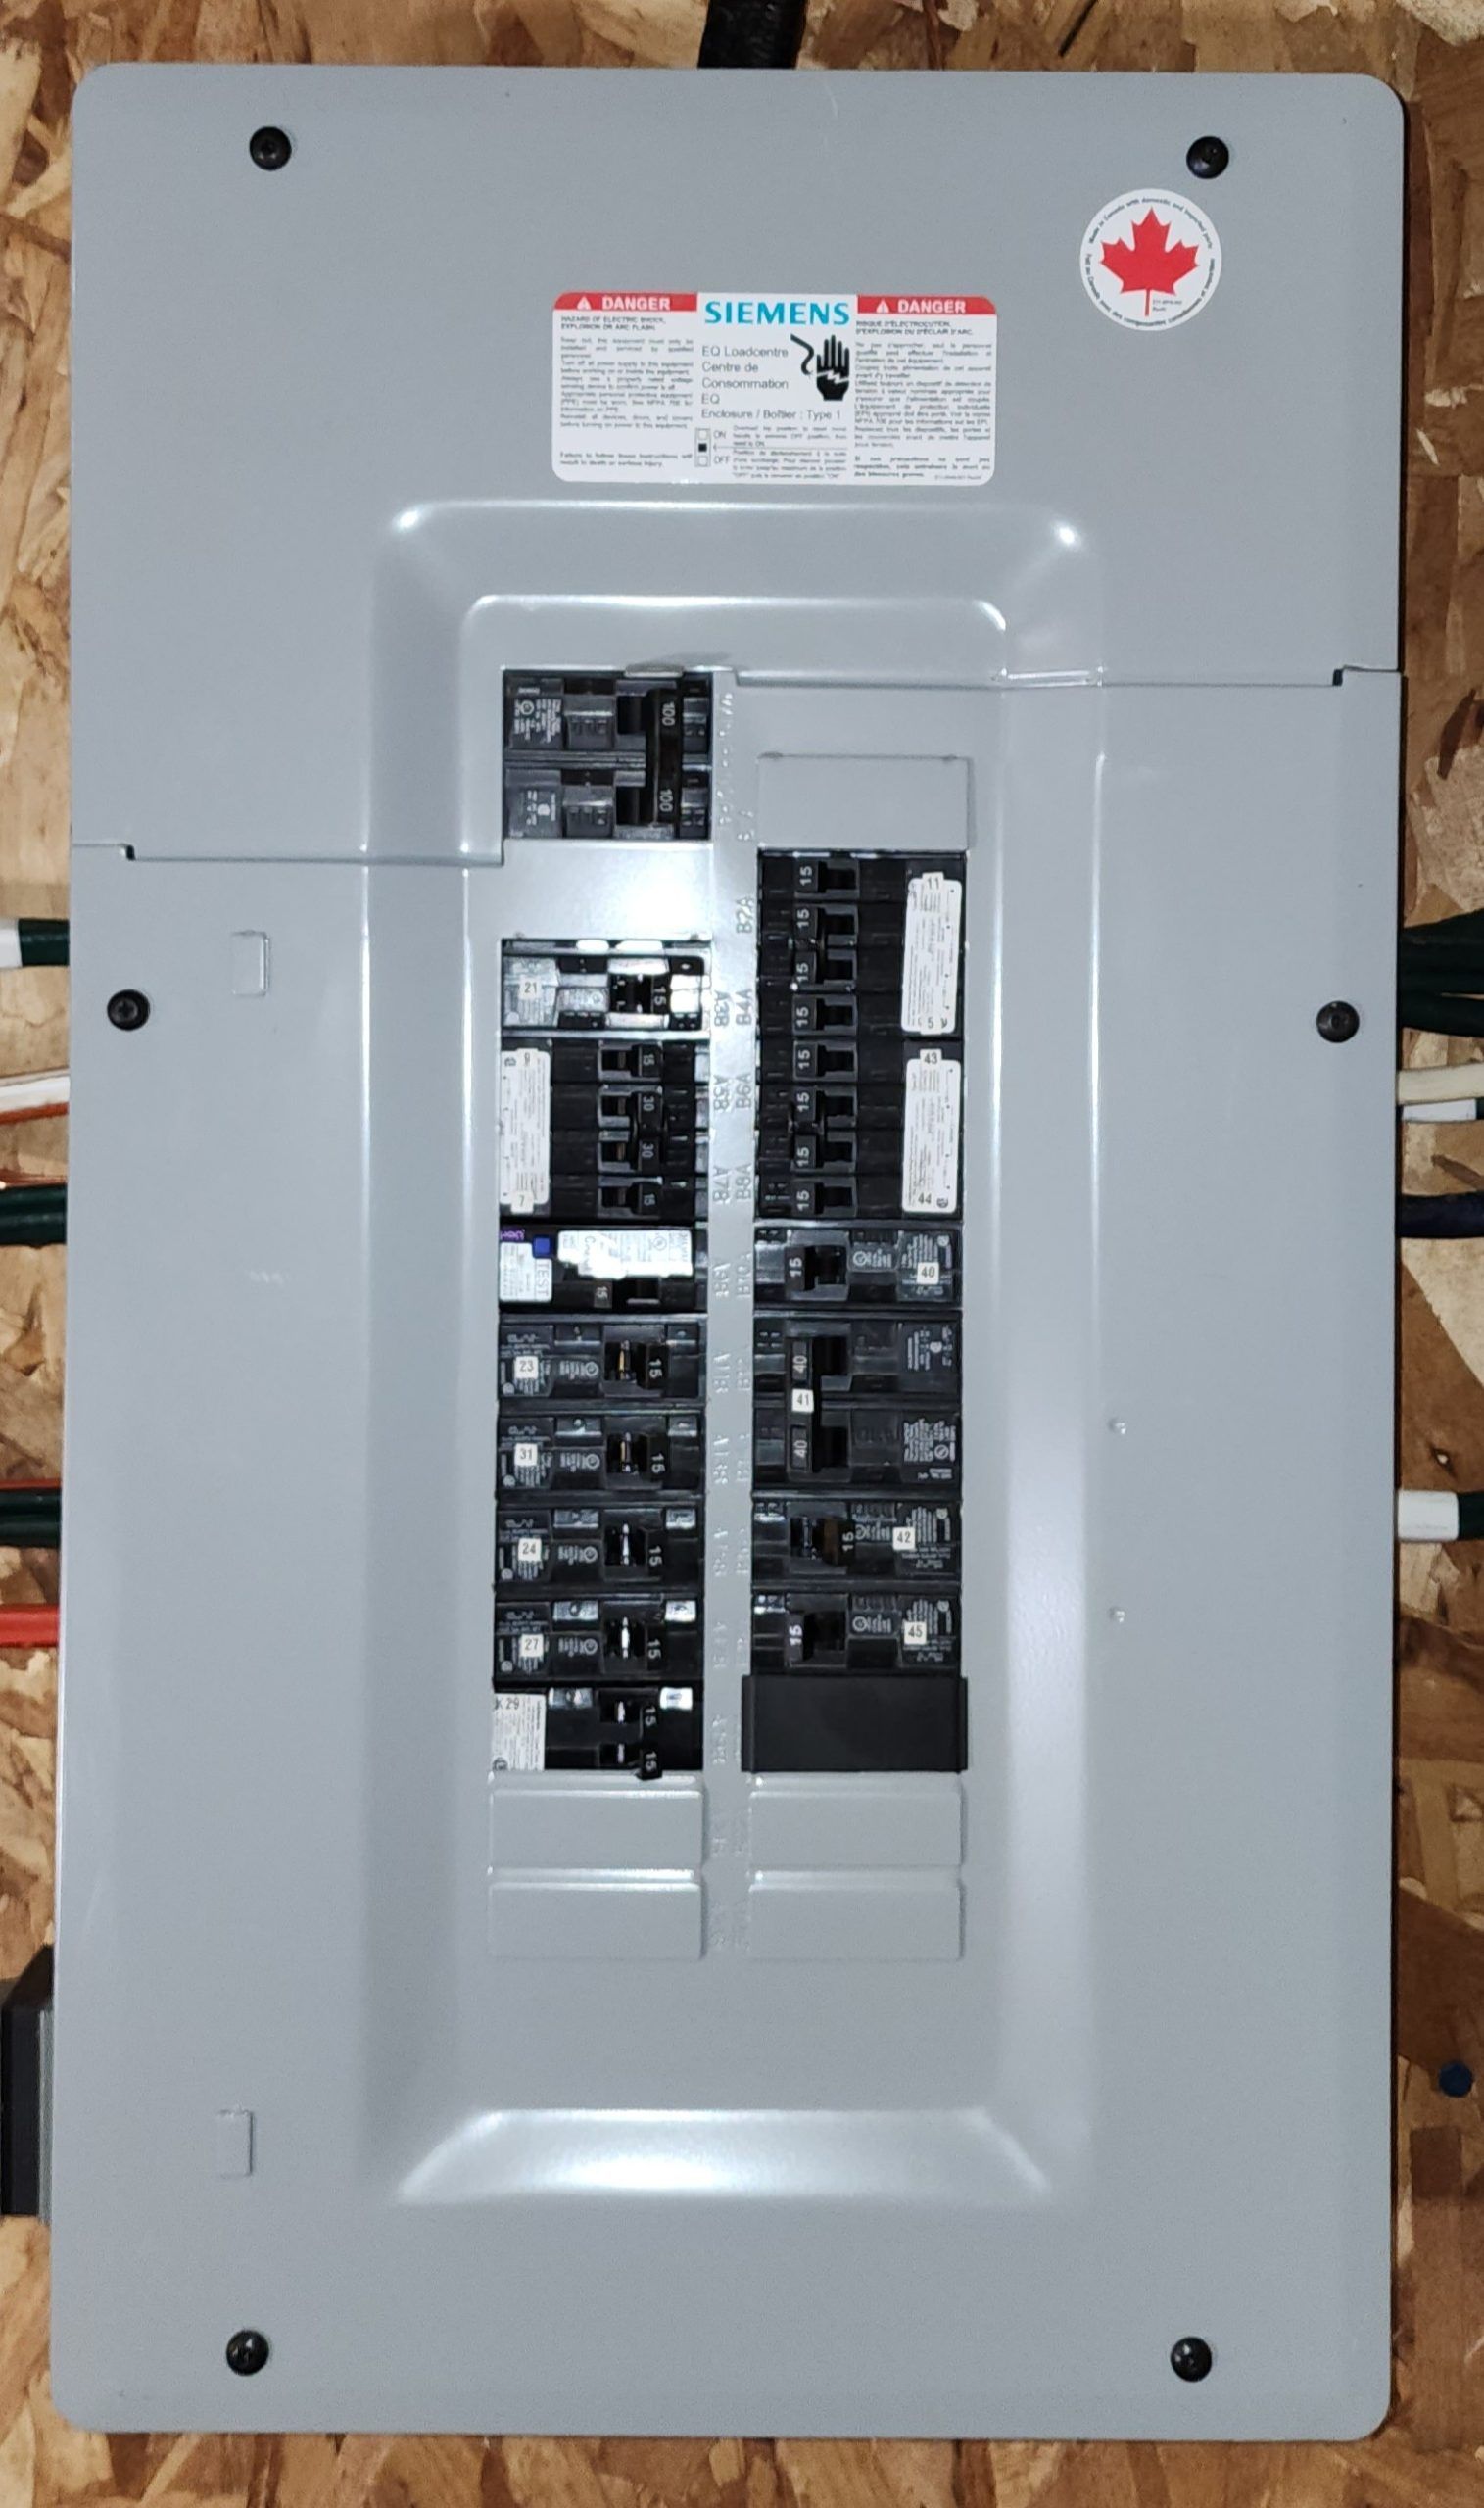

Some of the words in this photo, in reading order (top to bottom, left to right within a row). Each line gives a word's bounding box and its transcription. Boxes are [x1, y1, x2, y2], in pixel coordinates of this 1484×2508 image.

[601, 296, 671, 310] DANGER
[897, 299, 967, 314] DANGER
[704, 301, 850, 325] SIEMENS
[702, 346, 721, 358] EQ
[724, 346, 789, 358] Loadcentre
[702, 362, 742, 373] Centre
[744, 362, 759, 373] de
[702, 378, 789, 389] Consommation
[701, 394, 720, 405] EQ
[701, 410, 752, 419] Enclosure
[755, 409, 761, 419] /
[807, 410, 832, 421] Type
[714, 456, 730, 464] OFF
[661, 701, 676, 727] 100
[659, 789, 673, 812] 100
[799, 865, 813, 886] 15
[797, 908, 810, 929] 15
[796, 962, 809, 983] 15
[524, 982, 538, 993] 21
[652, 986, 667, 1006] 15
[713, 990, 730, 1027] A3B
[735, 989, 752, 1027] B4A
[796, 1006, 809, 1027] 15
[643, 1054, 655, 1066] 15
[797, 1049, 810, 1070] 15
[924, 1052, 937, 1064] 43
[736, 1074, 752, 1109] B6A
[643, 1096, 654, 1111] 30
[797, 1092, 810, 1112] 15
[642, 1143, 654, 1158] 30
[797, 1147, 810, 1167] 15
[735, 1164, 752, 1200] B8A
[643, 1193, 655, 1206] 15
[797, 1190, 810, 1211] 15
[917, 1193, 932, 1204] 44
[789, 1257, 802, 1278] 15
[920, 1267, 935, 1278] 40
[536, 1263, 550, 1296] TEST
[595, 1286, 608, 1300] 15
[519, 1360, 534, 1372] 23
[649, 1359, 662, 1378] 15
[792, 1355, 807, 1374] 40
[797, 1394, 810, 1405] 41
[520, 1448, 533, 1460] 31
[793, 1439, 807, 1458] 40
[651, 1453, 665, 1473] 15
[842, 1531, 854, 1552] 15
[896, 1531, 911, 1543] 42
[522, 1542, 537, 1554] 24
[649, 1546, 662, 1567] 15
[789, 1624, 802, 1645] 15
[908, 1626, 923, 1638] 45
[524, 1638, 538, 1650] 27
[647, 1639, 661, 1660] 15
[645, 1706, 656, 1726] 15
[645, 1752, 656, 1772] 15
